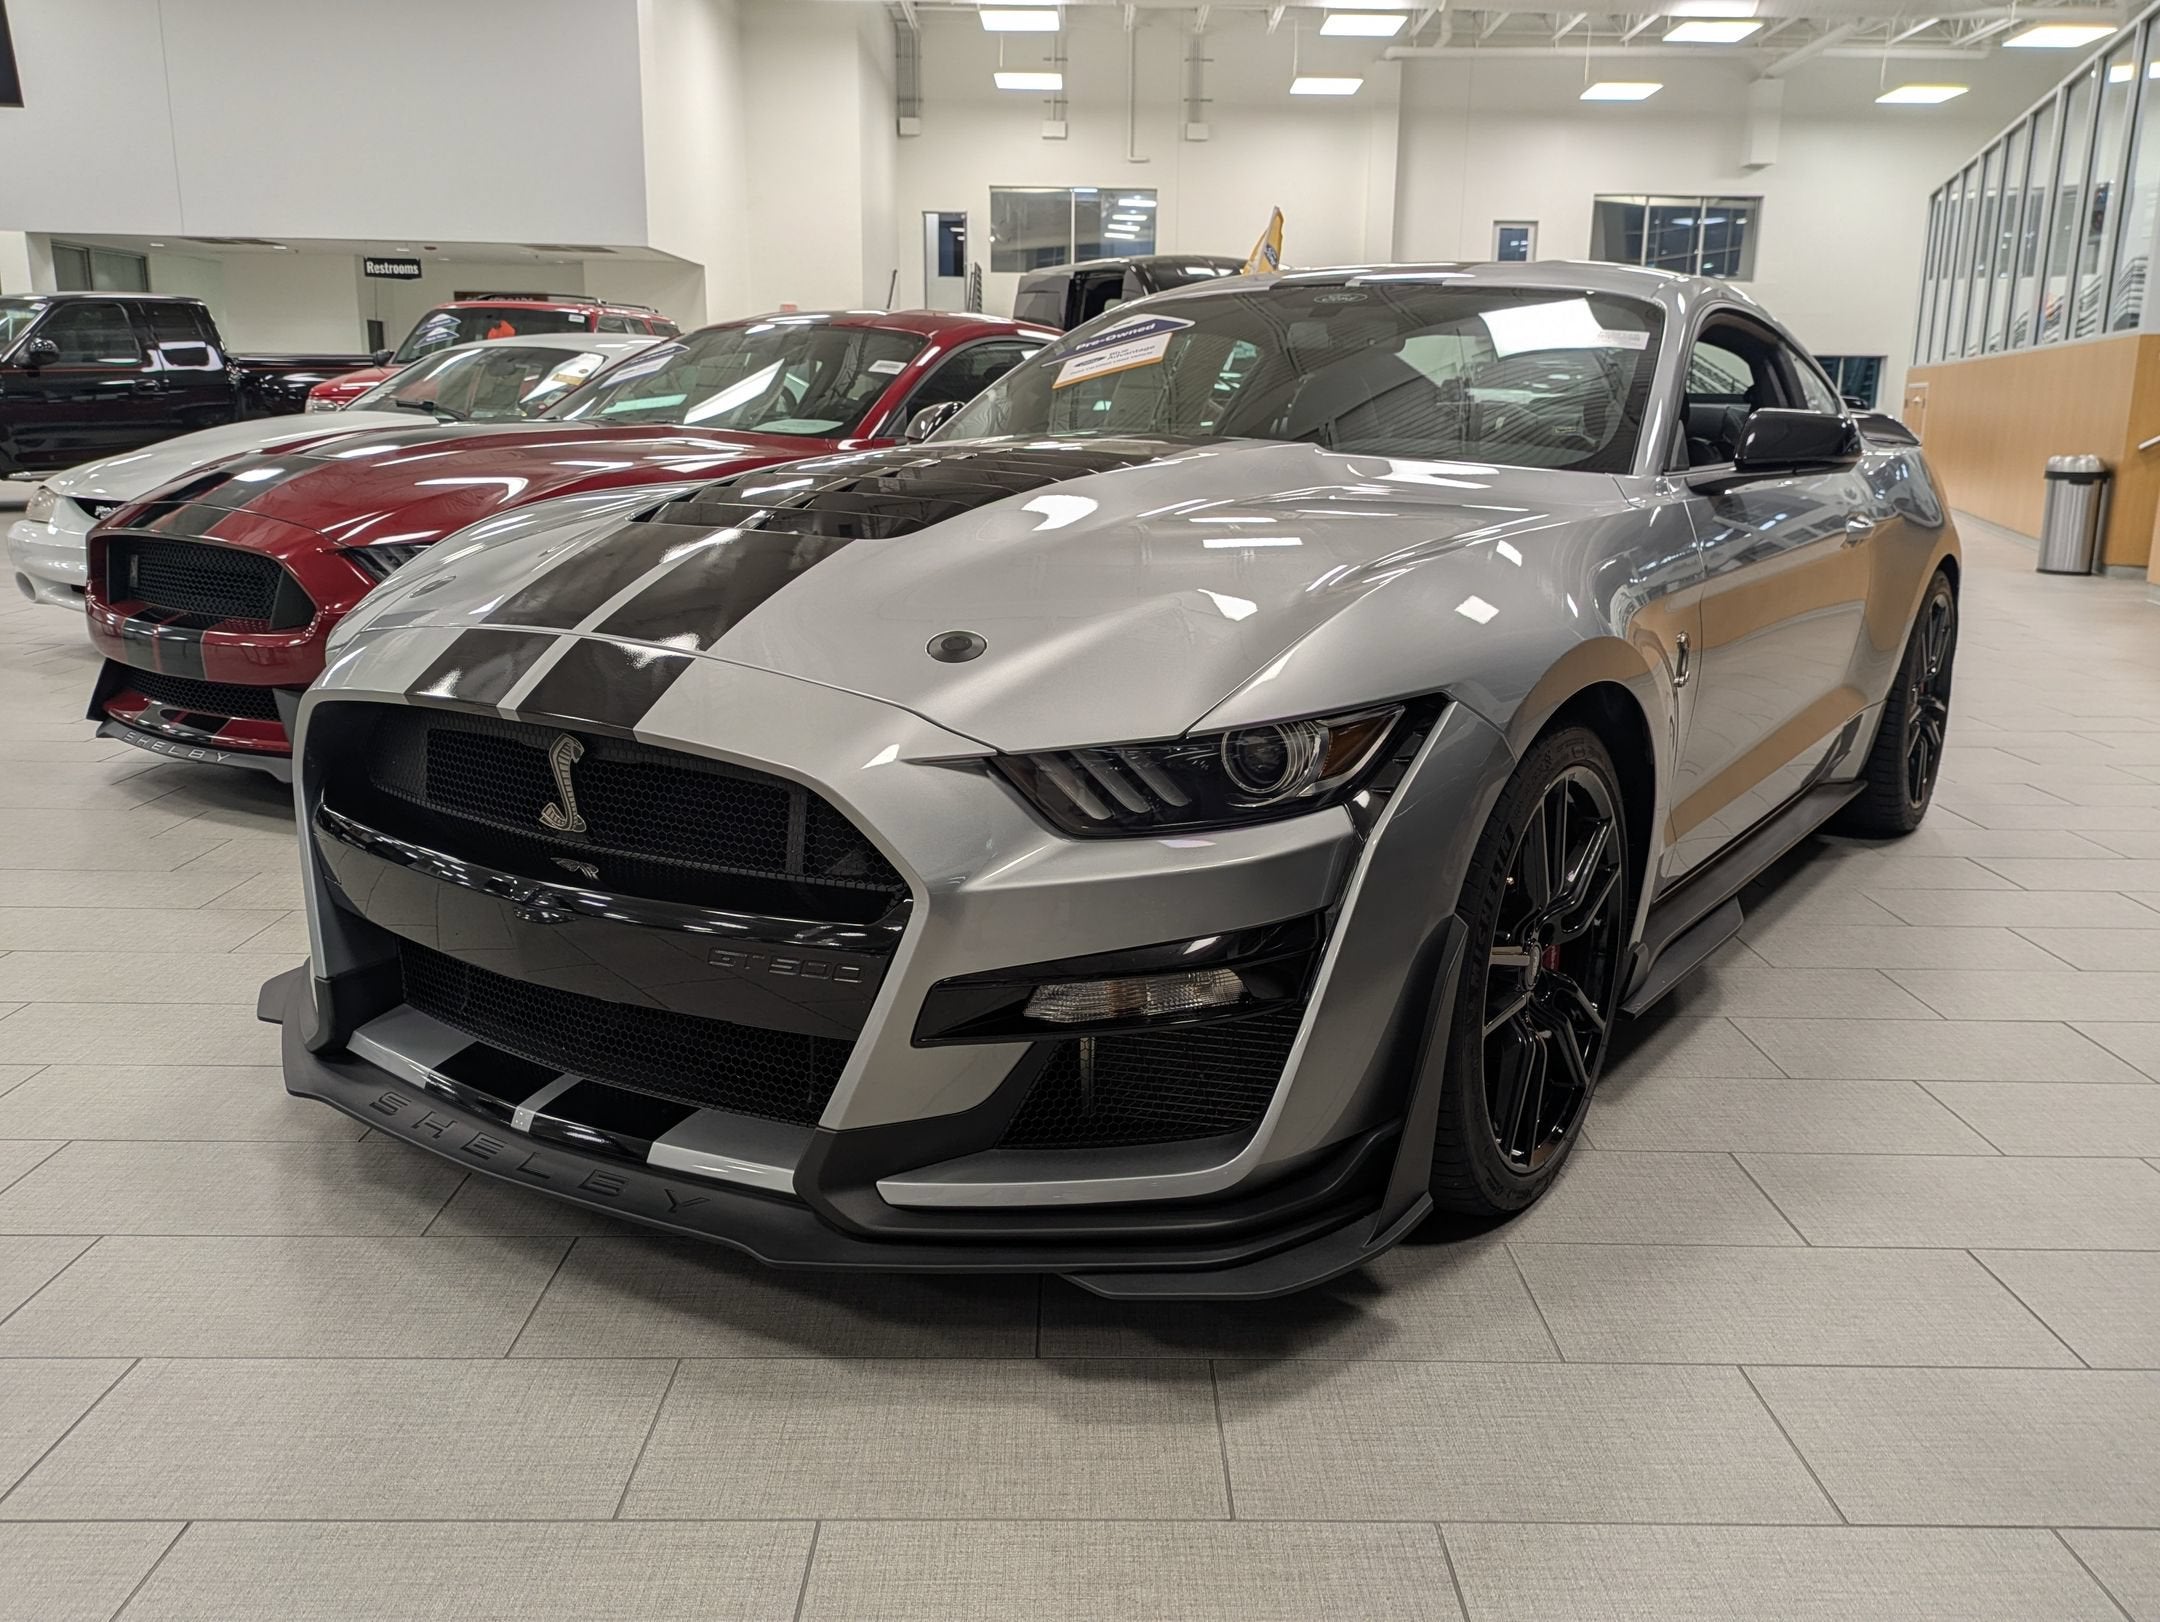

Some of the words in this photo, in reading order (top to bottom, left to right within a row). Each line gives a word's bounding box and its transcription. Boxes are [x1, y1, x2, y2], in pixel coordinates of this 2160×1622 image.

[366, 261, 420, 275] Restrooms
[1075, 323, 1156, 351] Pre-Owned
[123, 731, 231, 762] SHELBY
[707, 947, 864, 984] GT500
[368, 1090, 712, 1214] SHELBY
